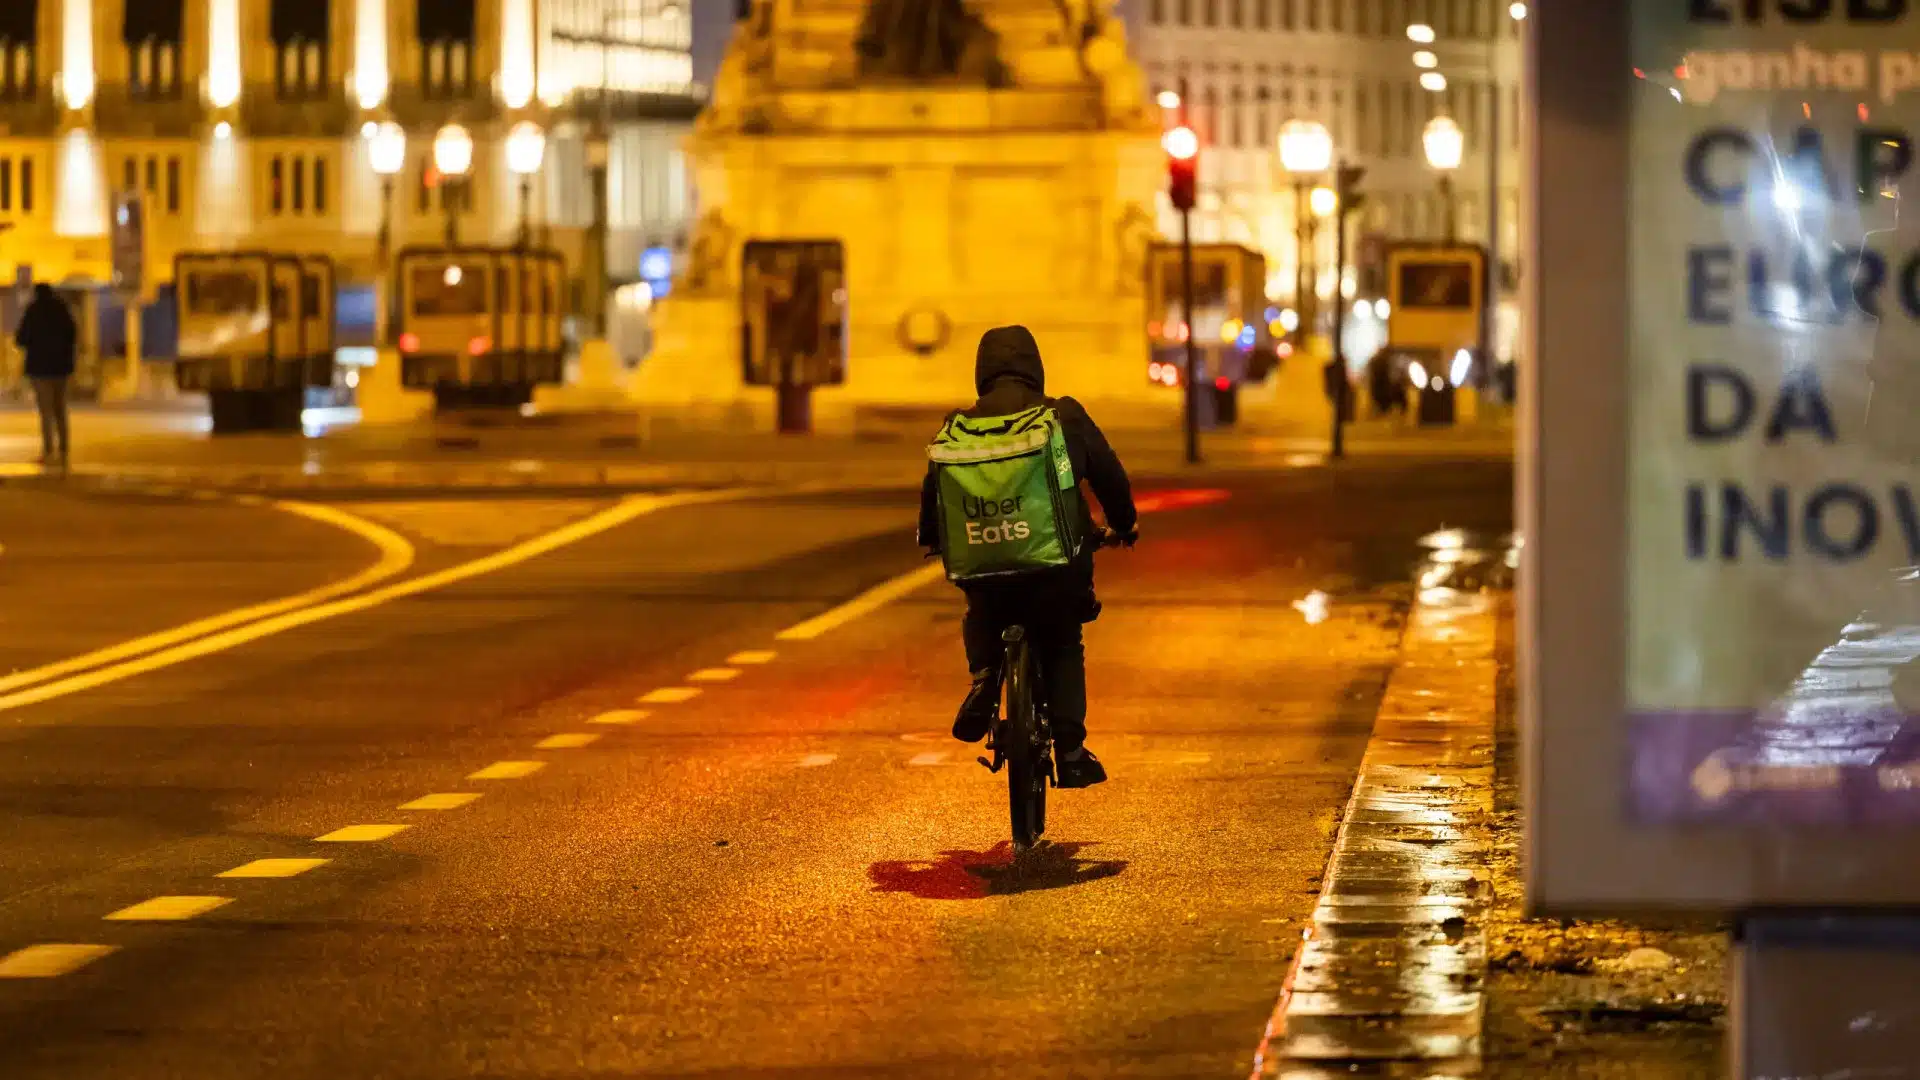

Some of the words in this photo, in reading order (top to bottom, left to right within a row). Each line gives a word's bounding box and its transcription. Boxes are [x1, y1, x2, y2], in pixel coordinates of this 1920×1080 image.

[1683, 41, 1867, 104] ganha
[1687, 362, 1837, 444] DA
[962, 495, 1024, 518] Uber
[965, 519, 1031, 545] Eats
